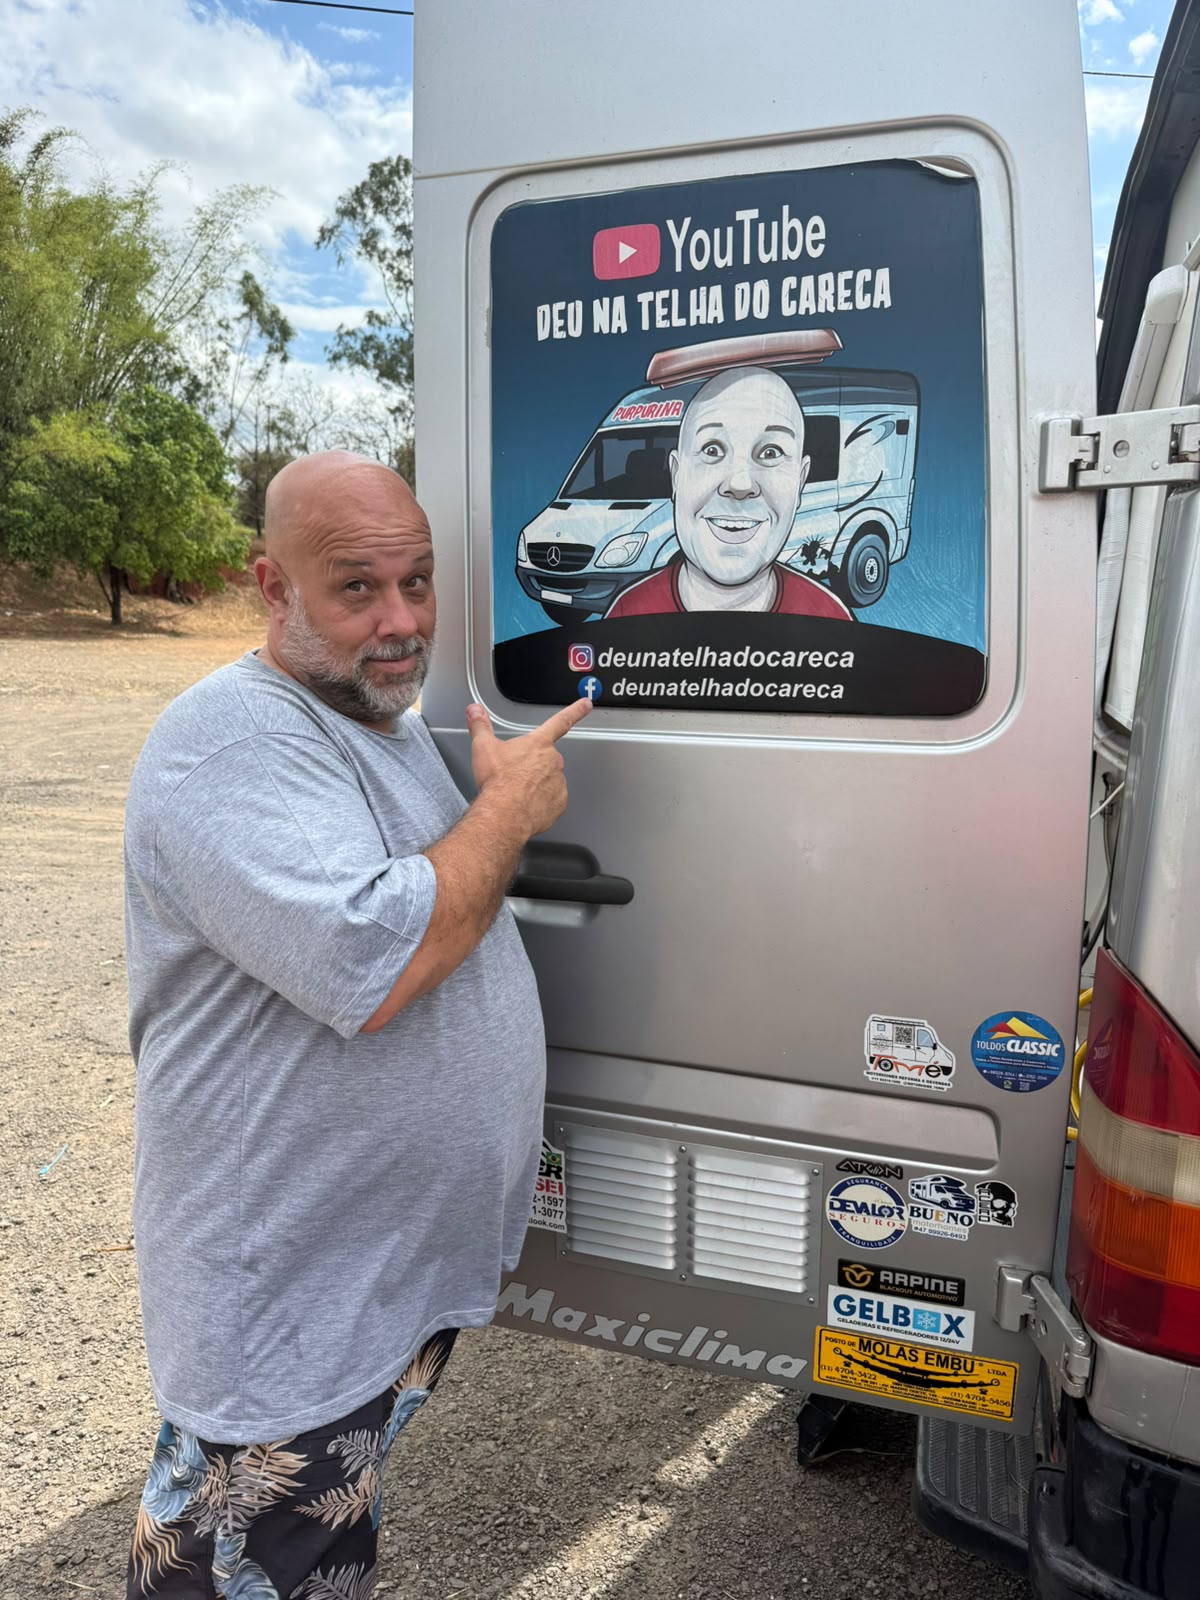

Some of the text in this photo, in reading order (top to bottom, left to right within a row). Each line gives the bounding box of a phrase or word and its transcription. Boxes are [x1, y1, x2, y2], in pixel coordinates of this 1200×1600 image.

[666, 205, 826, 272] YouTube
[536, 267, 892, 341] DEU NA TELHA DO CARECA
[612, 400, 683, 421] PURPURINA
[598, 646, 855, 668] deunatelhadocareca
[612, 678, 845, 699] deunatelhadocareca
[976, 1039, 1060, 1057] TOLDOS CLASSIC
[846, 1178, 889, 1191] SEGURANÇA
[829, 1212, 906, 1229] SEGUROS
[909, 1205, 974, 1227] BUENO
[838, 1227, 897, 1248] TRANQUILIDADE
[880, 1270, 958, 1295] ARPINE
[880, 1284, 958, 1302] BLACKOUT AUTOMOTIVO
[497, 1281, 808, 1379] Maxiclima
[837, 1317, 876, 1329] GELADEIRAS
[881, 1325, 939, 1341] REFRIGERADORES
[825, 1336, 846, 1346] POSTO
[859, 1338, 919, 1363] MOLAS
[924, 1351, 975, 1374] EMBU
[987, 1368, 1007, 1377] LTDA
